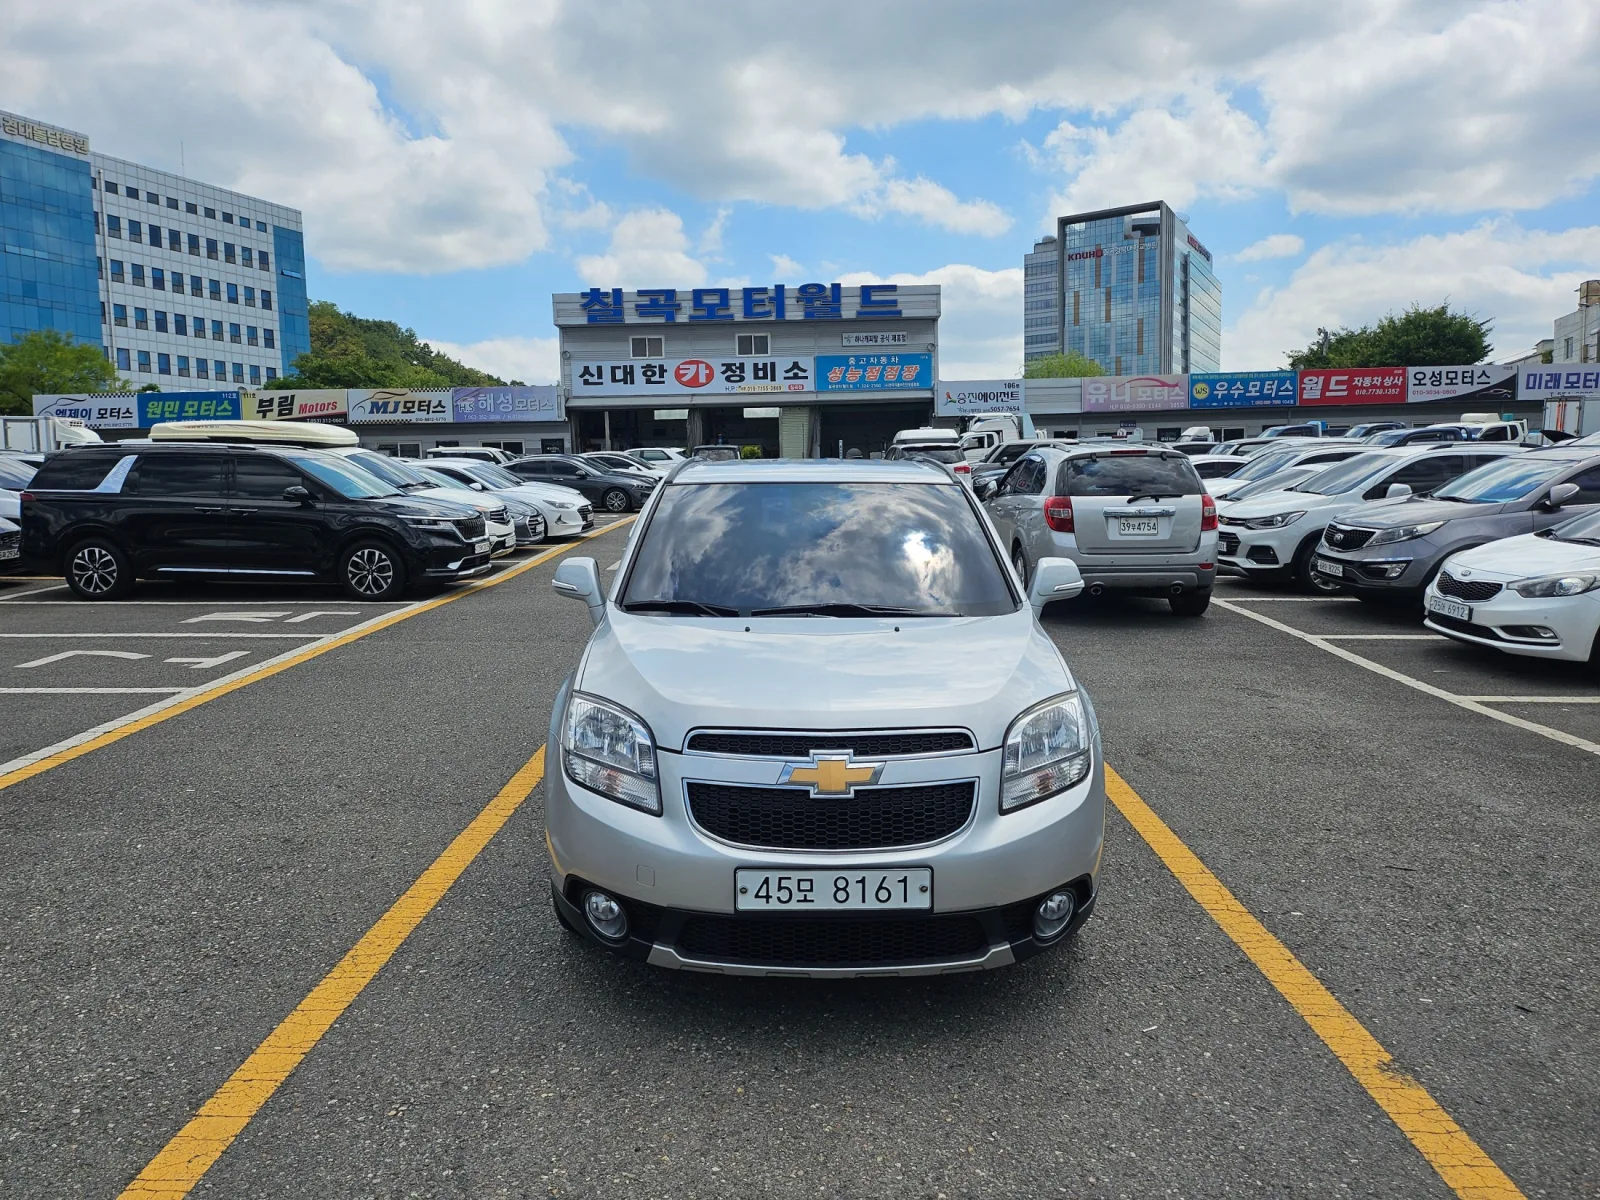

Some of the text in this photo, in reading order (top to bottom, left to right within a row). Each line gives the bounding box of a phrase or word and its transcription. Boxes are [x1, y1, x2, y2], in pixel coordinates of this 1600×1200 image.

[580, 283, 903, 323] 칠곡모터월드
[848, 356, 899, 365] 중고자동차
[578, 363, 668, 386] 신대한
[720, 361, 809, 383] 정비소
[827, 365, 920, 382] 성능점검장
[1413, 370, 1491, 386] 오성모터스
[1213, 380, 1294, 399] 우수모터스
[1302, 375, 1349, 399] 월드
[1352, 377, 1382, 386] 자동차
[1383, 376, 1403, 386] 상사
[957, 390, 1021, 404] 승진에이전트
[96, 407, 134, 420] 모터스
[256, 394, 338, 419] 부림 Motors
[1448, 603, 1465, 618] 6912
[754, 875, 909, 904] 45모 8161
